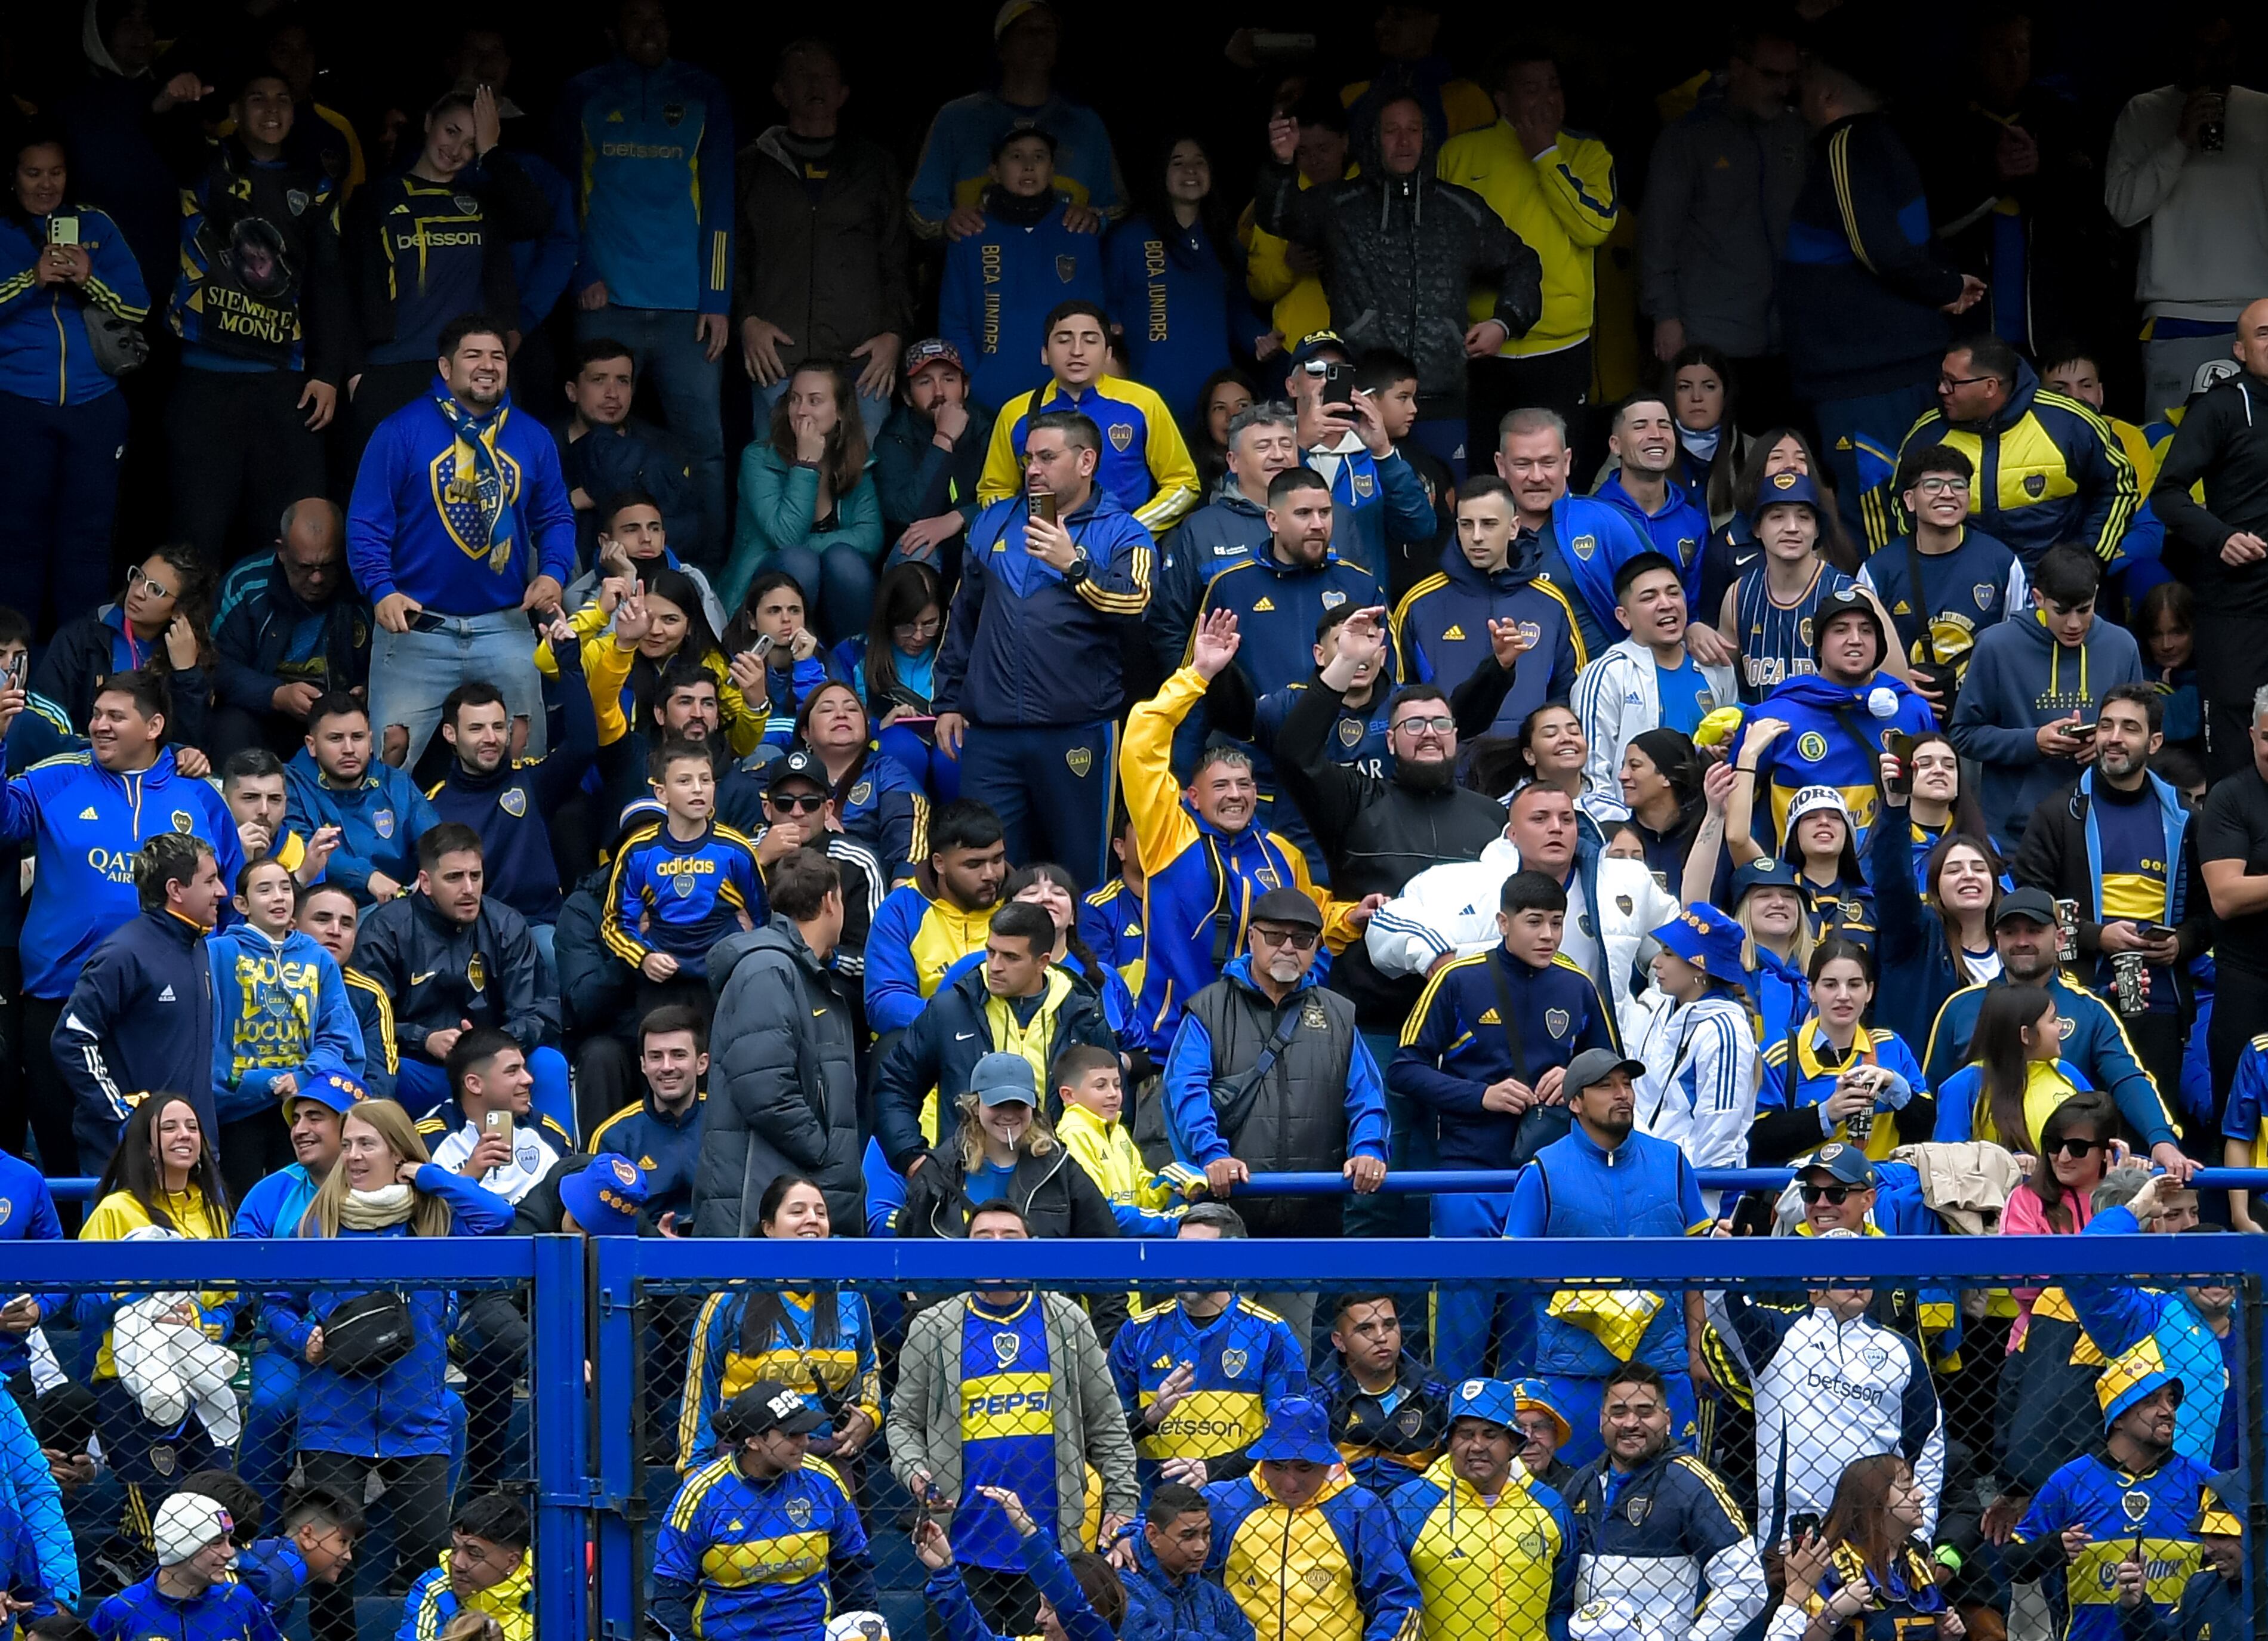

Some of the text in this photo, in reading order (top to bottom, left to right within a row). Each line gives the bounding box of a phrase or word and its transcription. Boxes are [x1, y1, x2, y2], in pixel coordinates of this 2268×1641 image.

[603, 140, 684, 159] betsson
[397, 230, 481, 250] betsson
[981, 245, 1001, 354] BOCA JUNIORS
[1144, 240, 1167, 342] BOCA JUNIORS
[88, 847, 135, 874] QAT
[657, 856, 714, 876] adidas
[1807, 1372, 1884, 1405] betsson
[968, 1391, 1052, 1418] PEPSI
[1155, 1417, 1242, 1438] etsson
